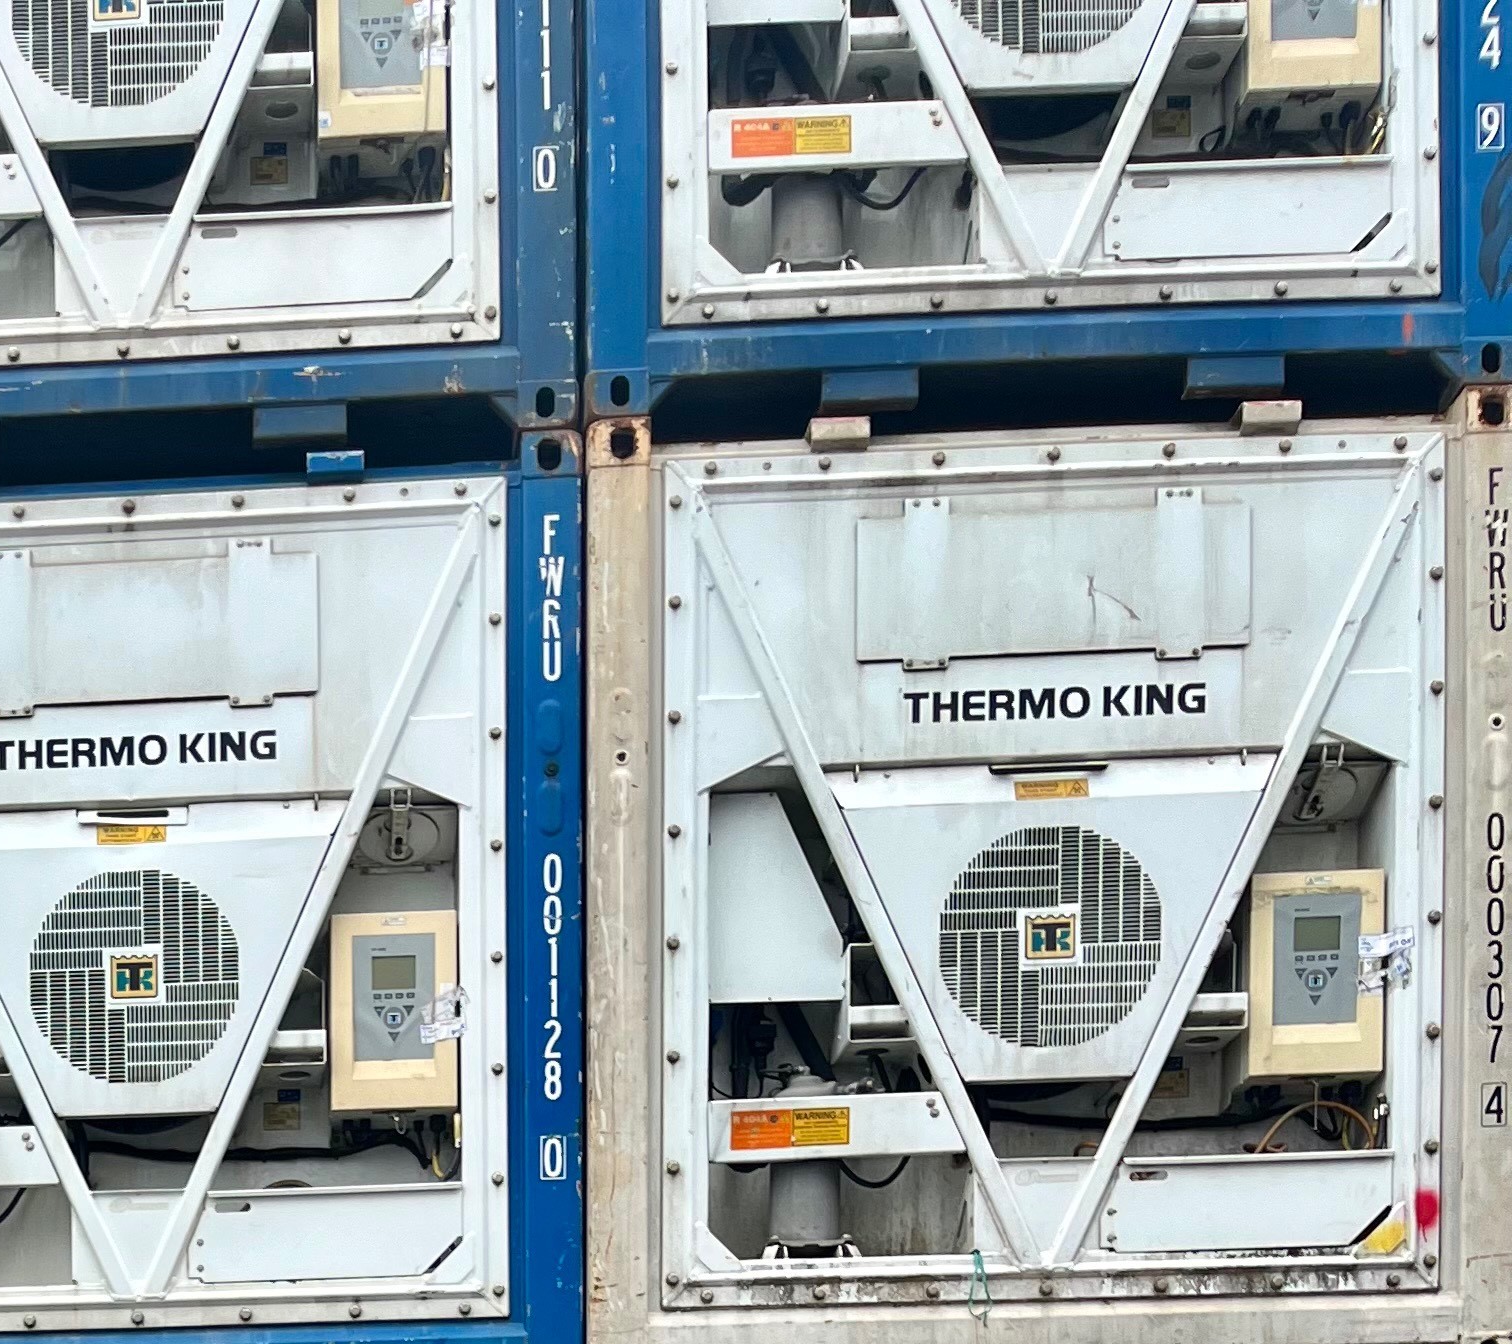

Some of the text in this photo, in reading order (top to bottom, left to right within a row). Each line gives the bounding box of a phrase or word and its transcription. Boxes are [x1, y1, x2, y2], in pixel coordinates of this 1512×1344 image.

[1481, 106, 1500, 149] 9
[903, 682, 1206, 724] THERMO KING
[179, 729, 277, 763] KING
[1484, 467, 1509, 1123] FWRU 000307 4
[539, 514, 565, 1177] FWRU 001128 0
[795, 1111, 836, 1120] WARNING
